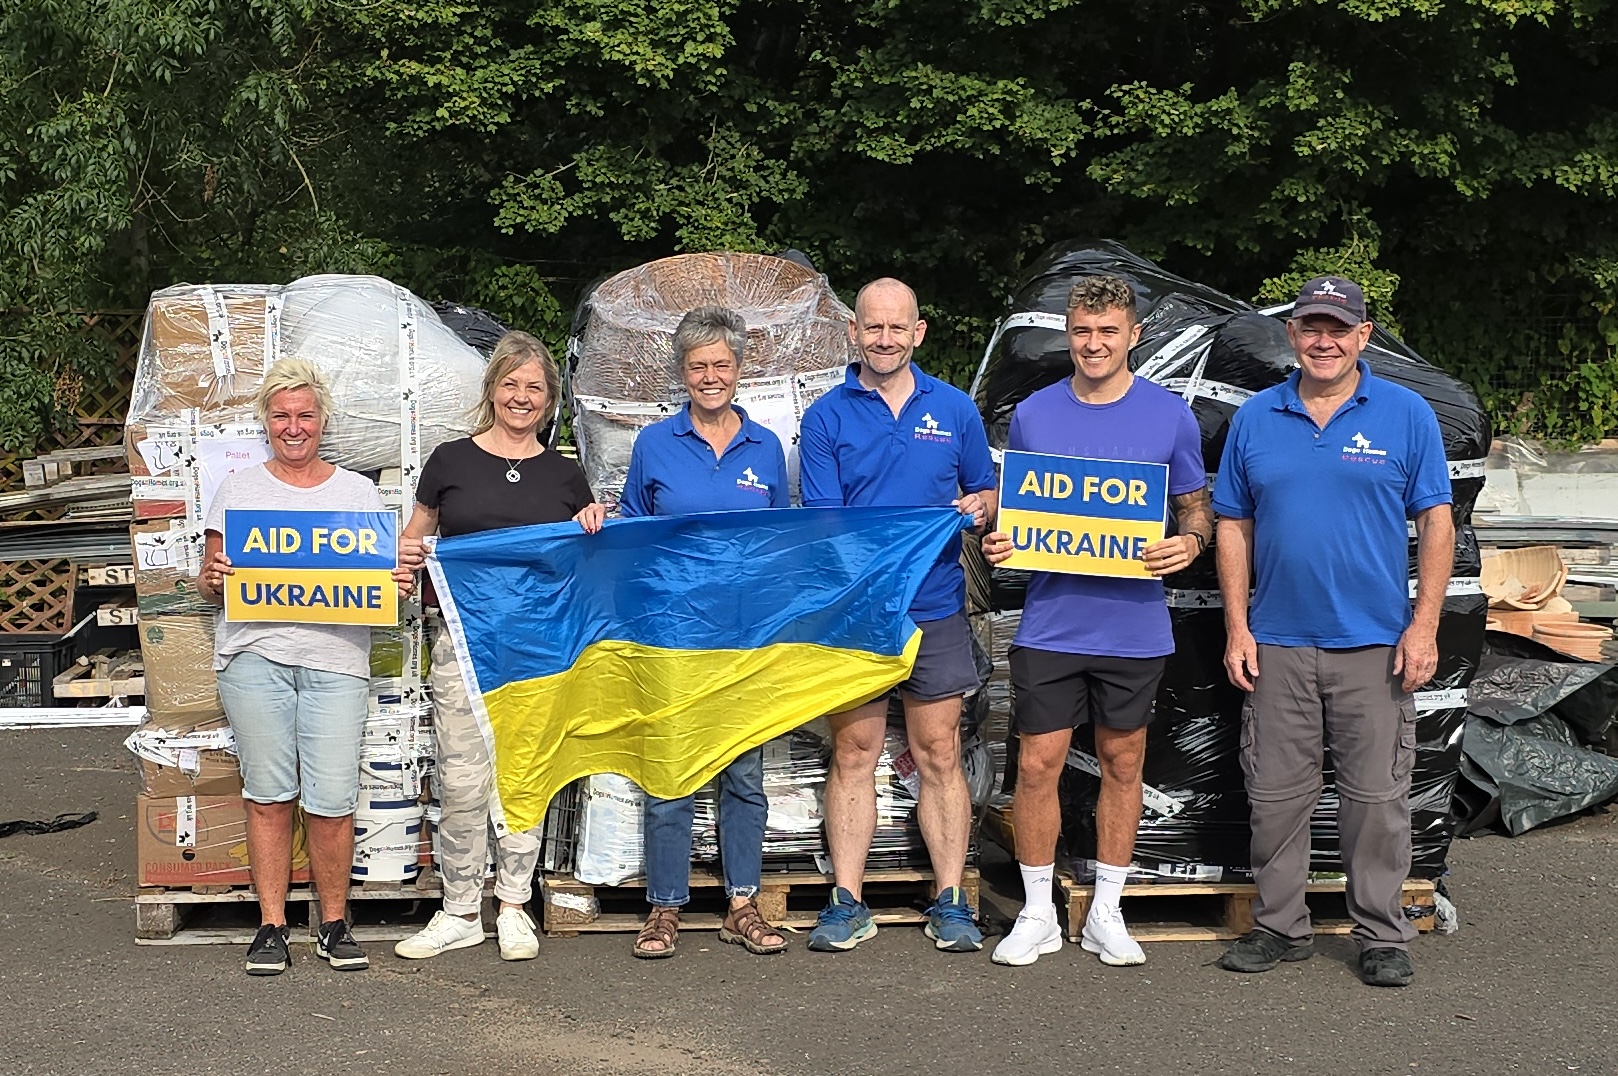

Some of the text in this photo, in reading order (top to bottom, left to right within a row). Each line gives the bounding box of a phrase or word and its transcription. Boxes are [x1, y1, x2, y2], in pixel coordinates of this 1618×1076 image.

[225, 450, 251, 460] Pallet
[1017, 470, 1148, 506] AID FOR
[242, 526, 379, 555] AID FOR
[1011, 525, 1148, 561] UKRAINE
[240, 582, 382, 610] UKRAINE
